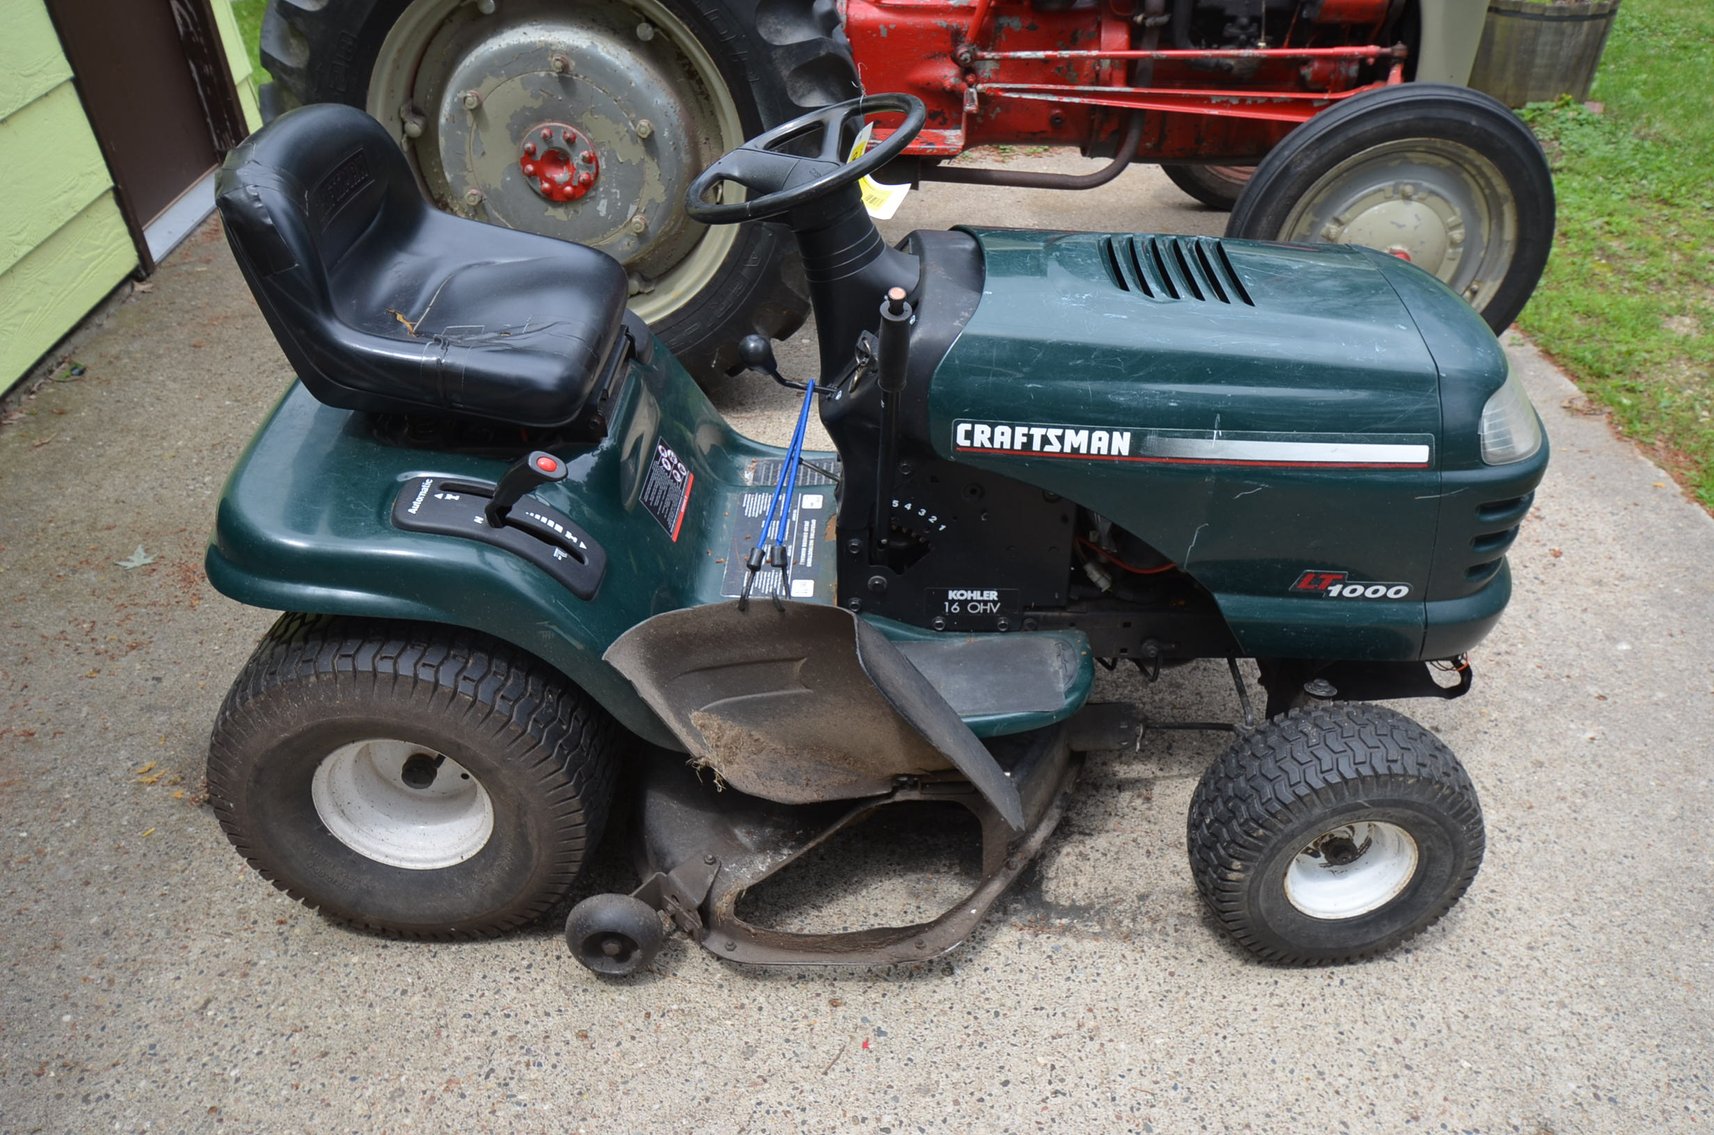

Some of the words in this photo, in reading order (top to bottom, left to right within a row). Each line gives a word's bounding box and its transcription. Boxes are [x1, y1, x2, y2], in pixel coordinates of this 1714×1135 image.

[956, 423, 1131, 456] CRAFTSMAN
[408, 479, 433, 514] Automatic
[474, 516, 484, 524] N
[918, 508, 926, 516] 3
[928, 515, 938, 523] 2
[1296, 573, 1344, 590] LT
[1327, 584, 1409, 599] 1000
[948, 590, 998, 600] KOHLER
[944, 602, 960, 613] 16
[967, 602, 1001, 613] OHV
